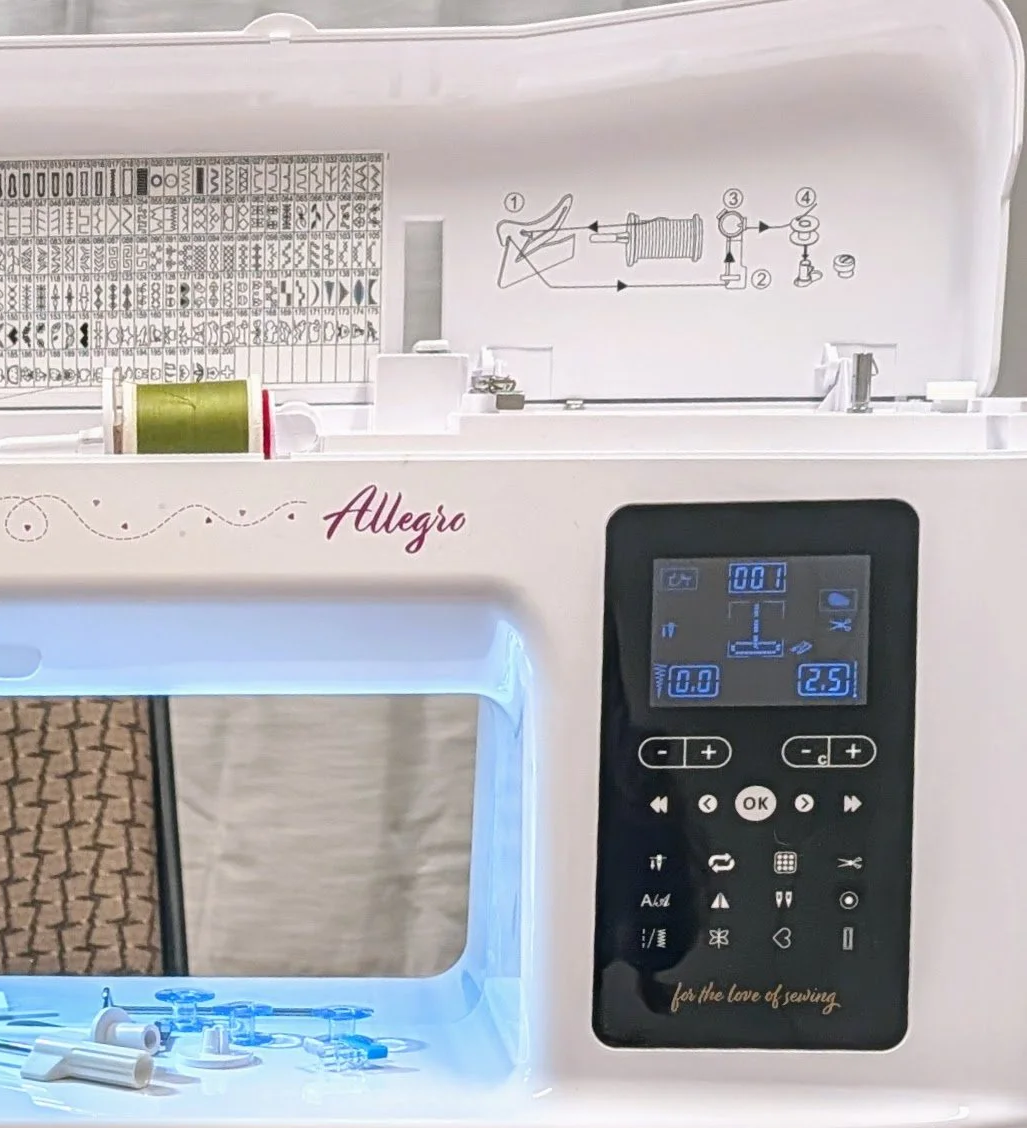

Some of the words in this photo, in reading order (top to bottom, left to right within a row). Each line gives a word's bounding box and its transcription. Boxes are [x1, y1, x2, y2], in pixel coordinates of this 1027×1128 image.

[323, 484, 466, 554] Allegro
[733, 565, 781, 590] 001
[675, 669, 712, 693] 0.0
[804, 668, 842, 692] 2.5
[743, 796, 769, 810] OK
[671, 981, 695, 1012] for
[698, 981, 723, 1005] the
[727, 983, 759, 1003] love
[764, 983, 782, 1009] of
[782, 987, 842, 1015] sewing
